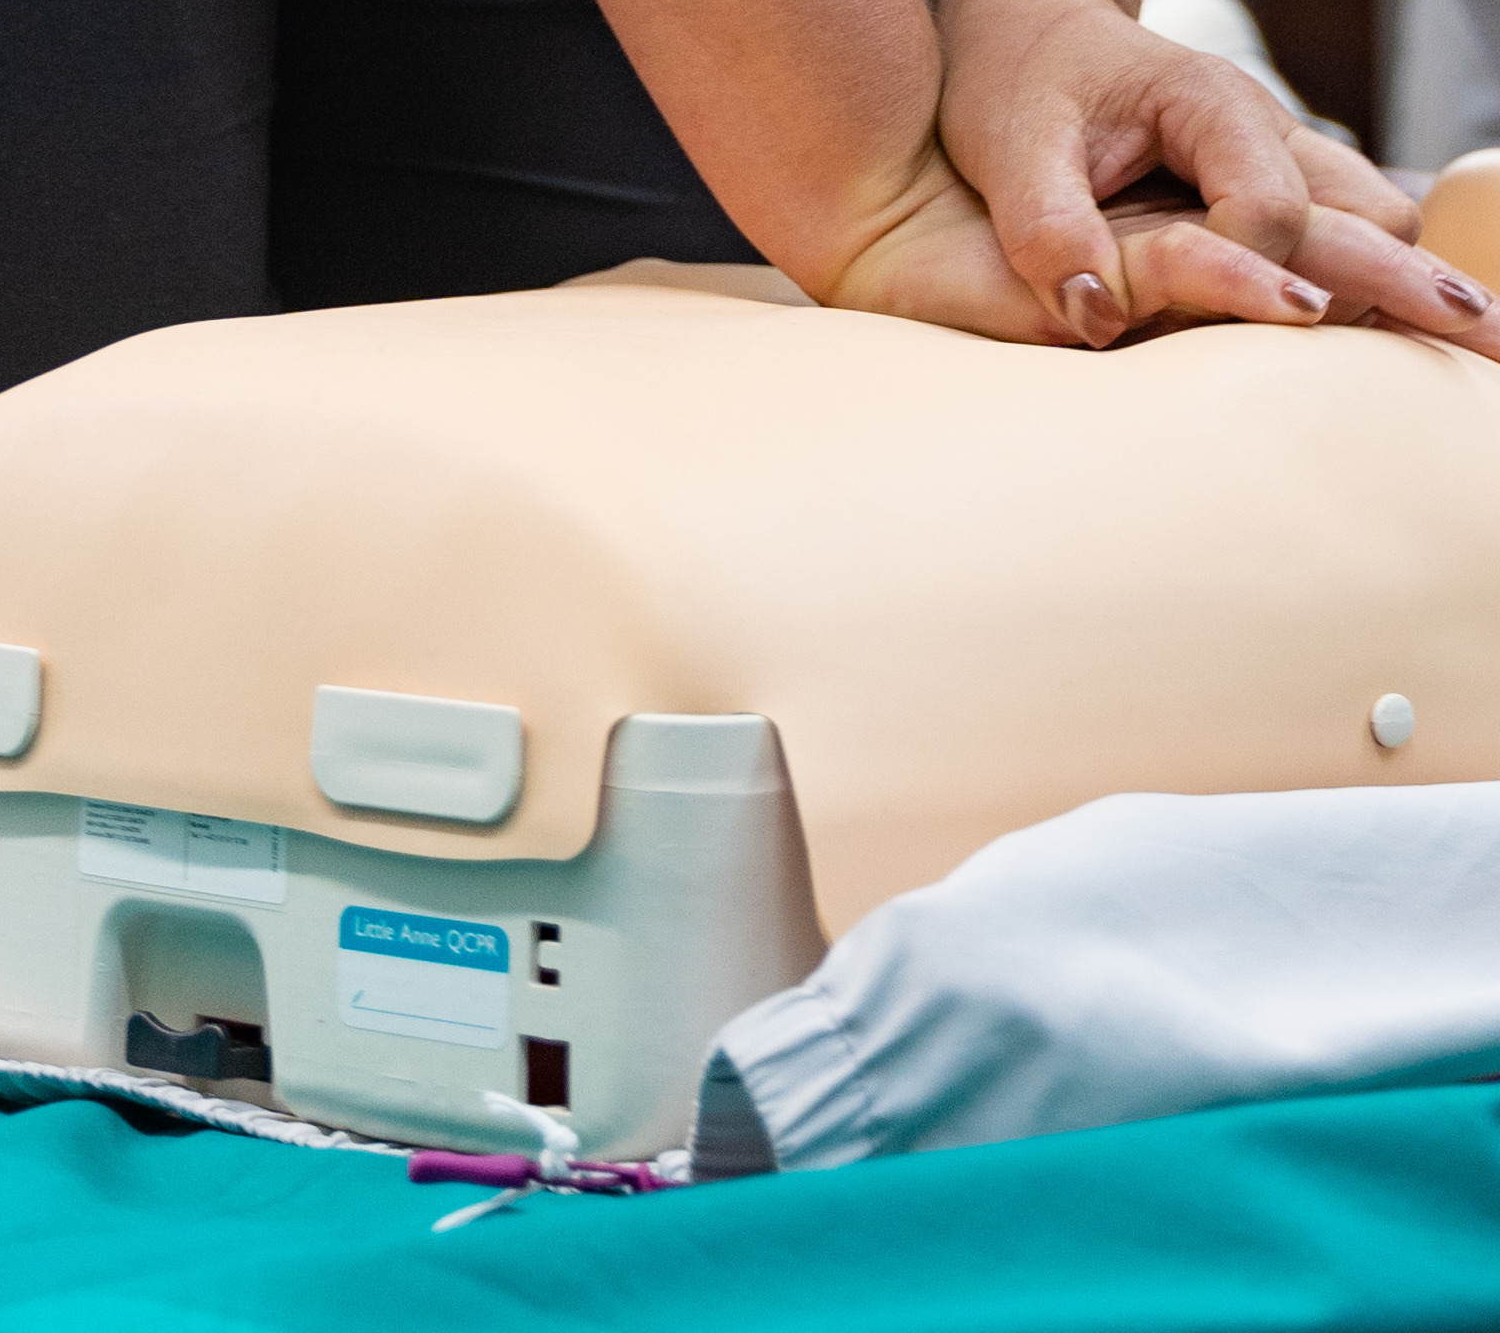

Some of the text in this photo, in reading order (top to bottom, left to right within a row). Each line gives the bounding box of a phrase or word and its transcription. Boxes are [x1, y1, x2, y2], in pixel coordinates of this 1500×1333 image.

[355, 915, 499, 957] Little Anne QCPR
